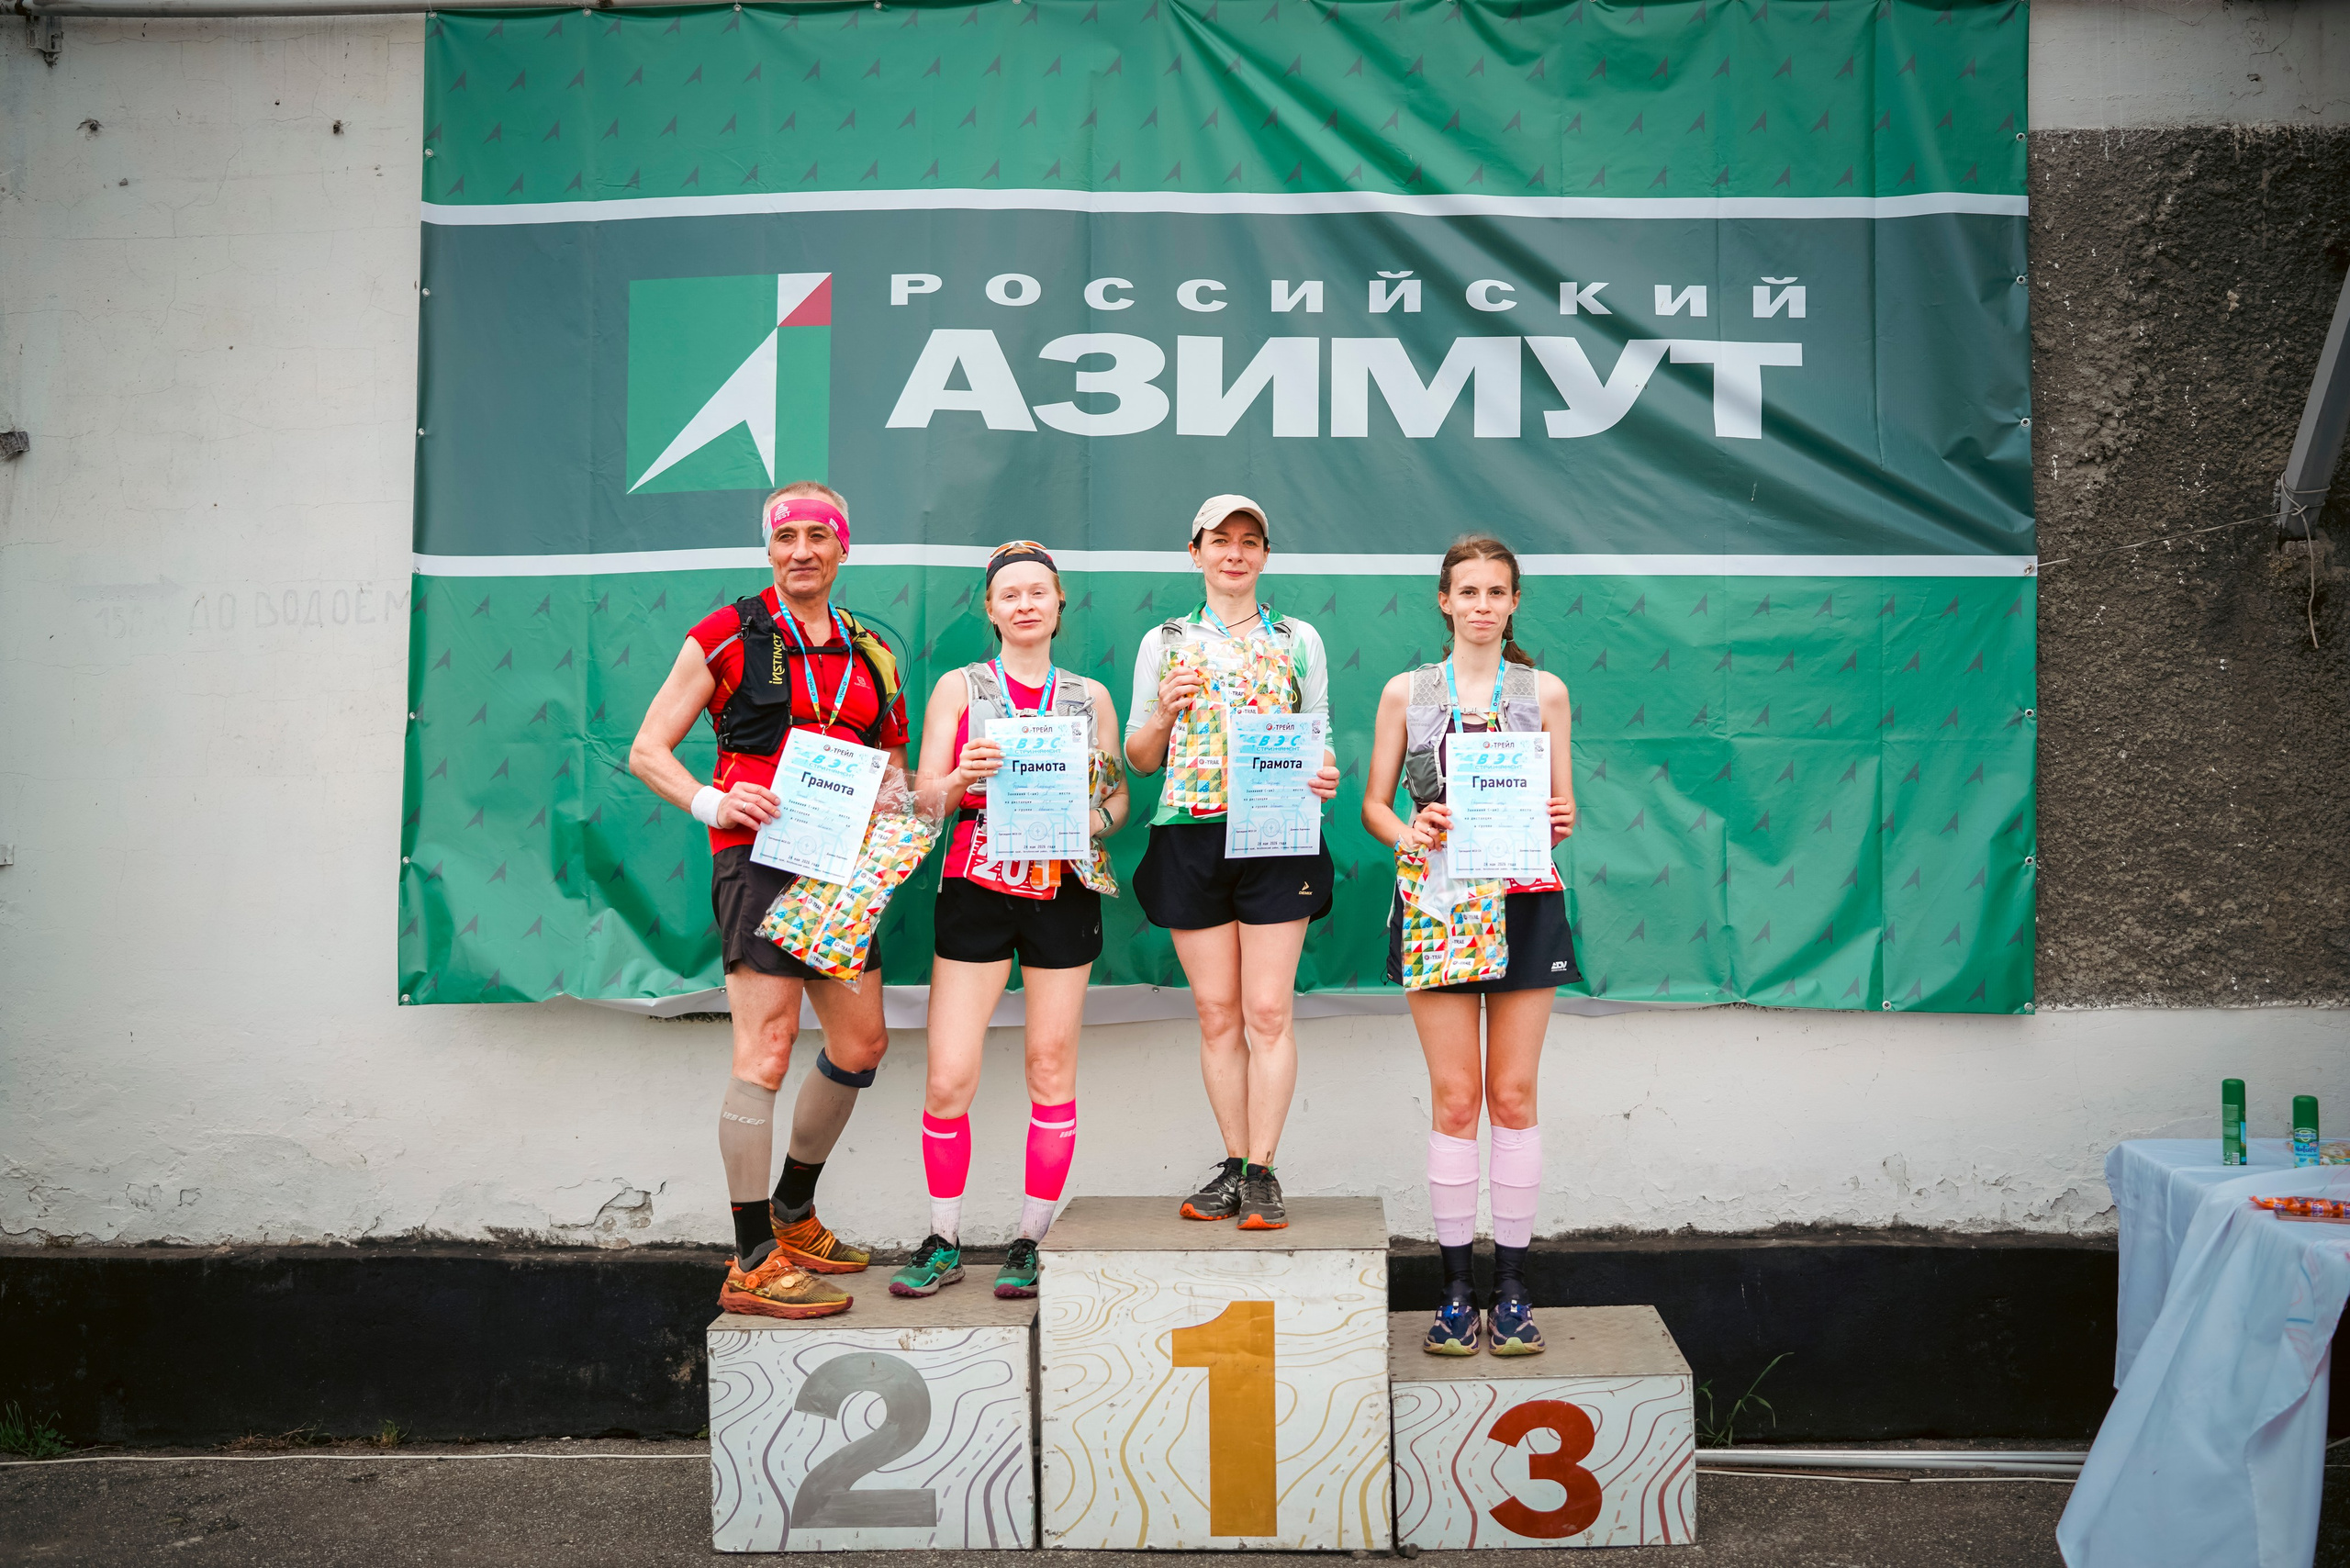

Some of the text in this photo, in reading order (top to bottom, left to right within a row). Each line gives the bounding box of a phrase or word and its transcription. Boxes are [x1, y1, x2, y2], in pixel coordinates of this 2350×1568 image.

[890, 269, 1806, 319] РОССИЙСКИЙ
[885, 328, 1803, 439] АЗИМУТ
[800, 771, 855, 796] Грамота
[1012, 760, 1066, 776] Грамота
[1252, 756, 1303, 772] Грамота
[1472, 776, 1528, 791] Грамота
[789, 1351, 937, 1529] 2
[1171, 1300, 1278, 1538] 1
[1487, 1399, 1604, 1540] 3
